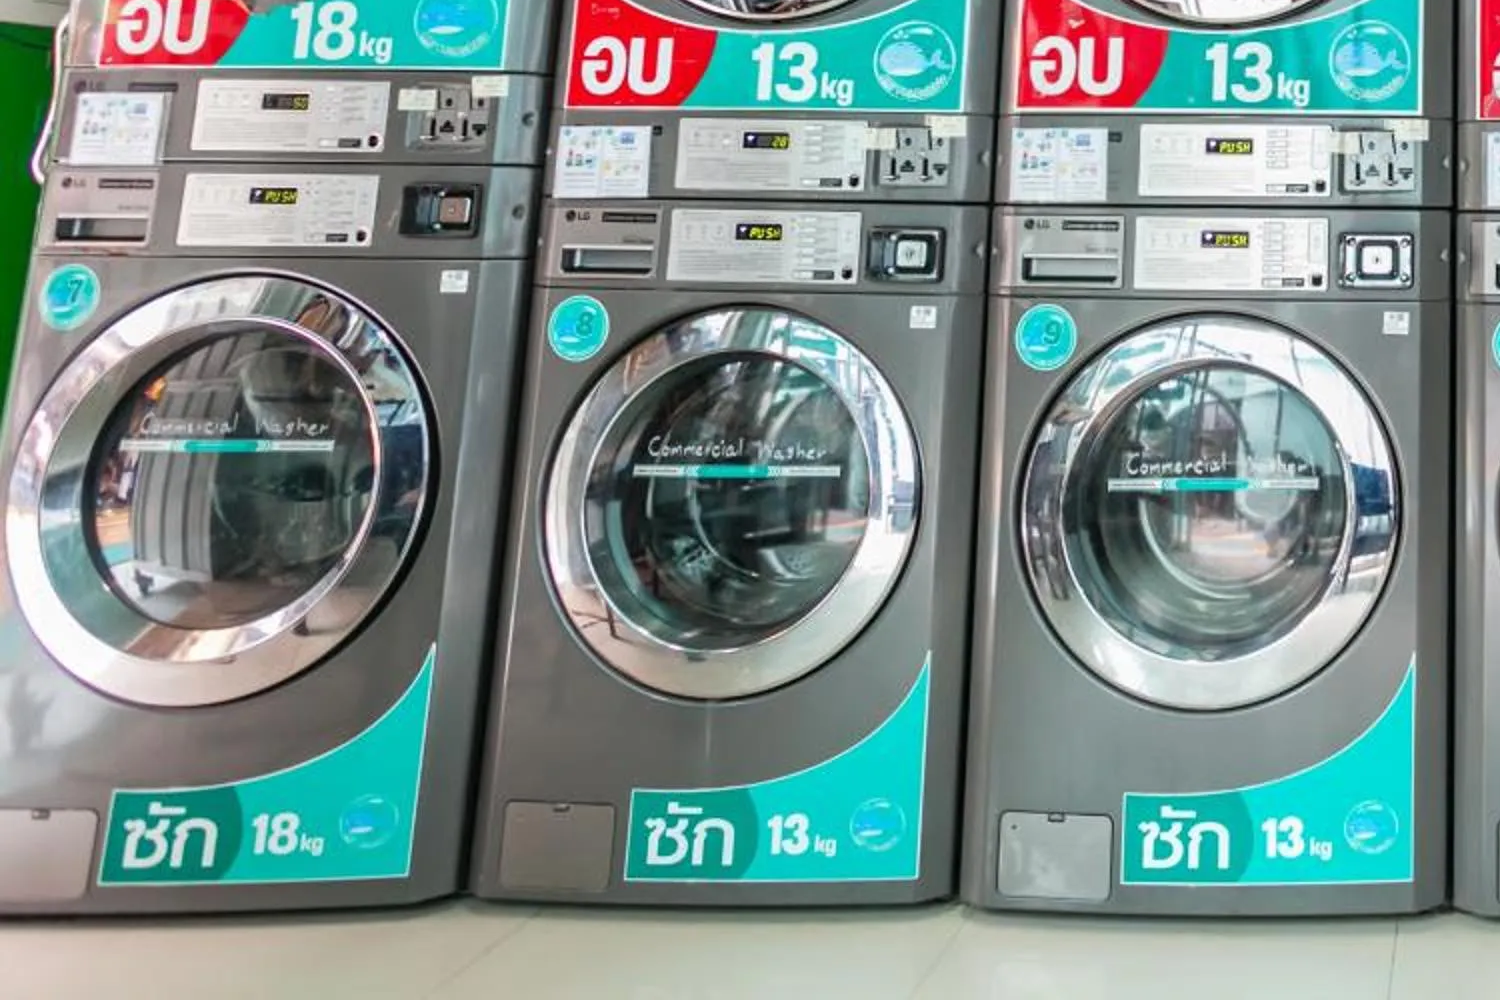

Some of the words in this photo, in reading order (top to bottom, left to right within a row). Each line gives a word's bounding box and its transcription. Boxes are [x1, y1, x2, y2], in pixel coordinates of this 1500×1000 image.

[581, 36, 673, 96] อบ
[1029, 36, 1124, 97] อบ
[1218, 140, 1252, 154] PUSH
[265, 190, 298, 204] PUSH
[748, 225, 783, 240] PUSH
[1213, 233, 1249, 247] PUSH
[68, 279, 83, 306] 7
[577, 309, 594, 335] 8
[1044, 318, 1062, 345] 9
[648, 434, 744, 460] Commercial
[752, 438, 828, 462] Washer
[1126, 452, 1228, 476] Commercial
[121, 802, 219, 871] ซัก
[644, 801, 736, 866] ซัก
[1138, 806, 1230, 871] ซัก
